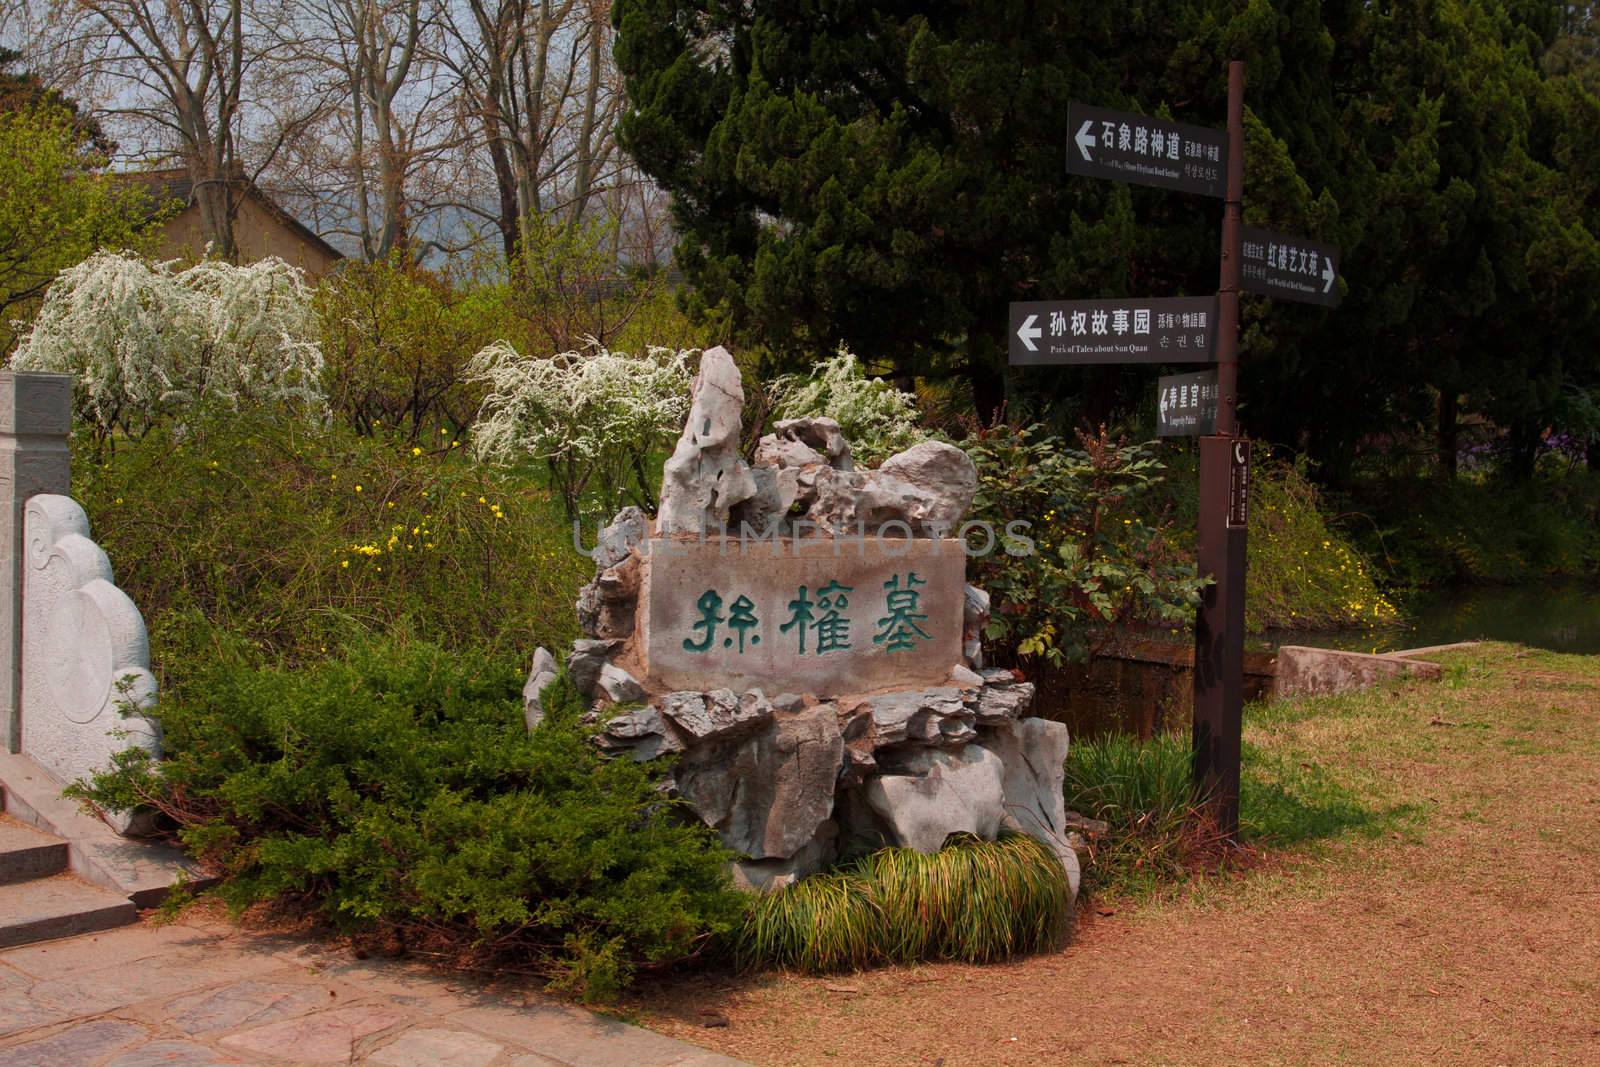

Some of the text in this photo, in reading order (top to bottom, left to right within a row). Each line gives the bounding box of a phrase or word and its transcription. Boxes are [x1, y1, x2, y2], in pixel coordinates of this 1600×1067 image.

[1102, 121, 1180, 160] 石象路神道
[1267, 242, 1318, 277] 红楼艺文苑
[1050, 309, 1150, 336] 孙权故事园
[1076, 344, 1094, 353] Tales
[1094, 344, 1114, 353] about
[1114, 343, 1129, 353] Sun
[1129, 343, 1148, 354] Quan
